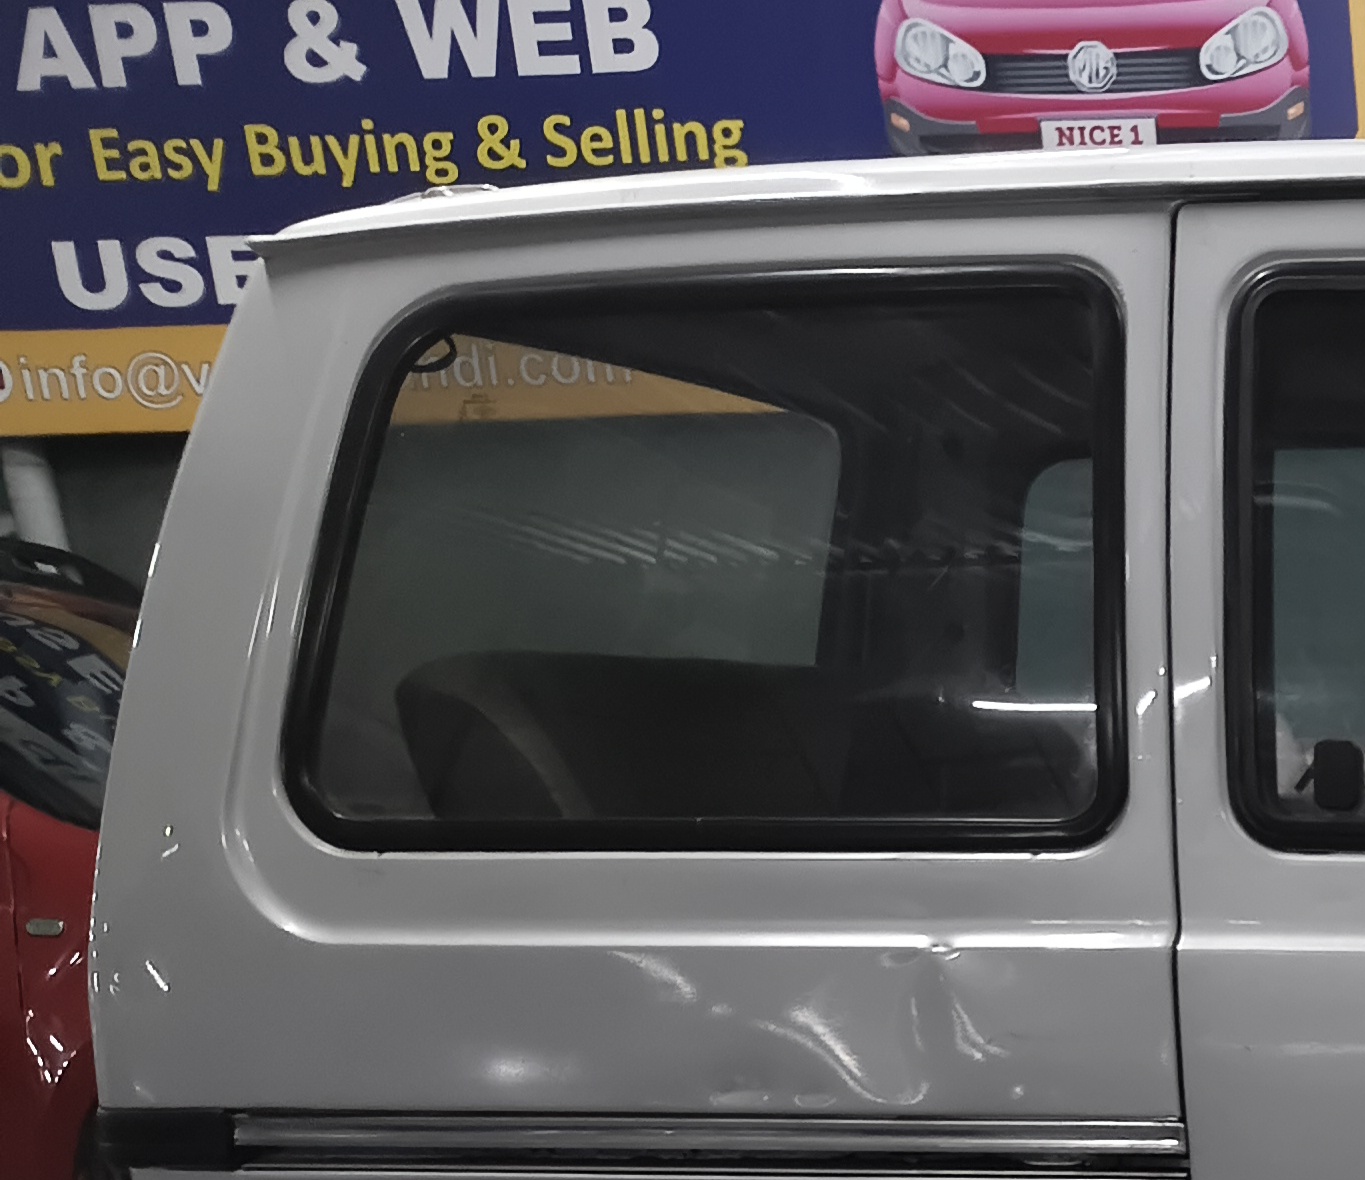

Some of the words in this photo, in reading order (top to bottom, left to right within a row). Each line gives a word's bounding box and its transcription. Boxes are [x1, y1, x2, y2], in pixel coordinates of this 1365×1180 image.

[16, 0, 233, 92] APP
[284, 0, 367, 82] &
[395, 0, 660, 80] WEB
[88, 127, 225, 192] Easy
[243, 118, 459, 188] Buying
[476, 114, 527, 171] &
[543, 108, 748, 169] Selling
[1055, 125, 1123, 147] NICE
[1130, 125, 1144, 146] 1
